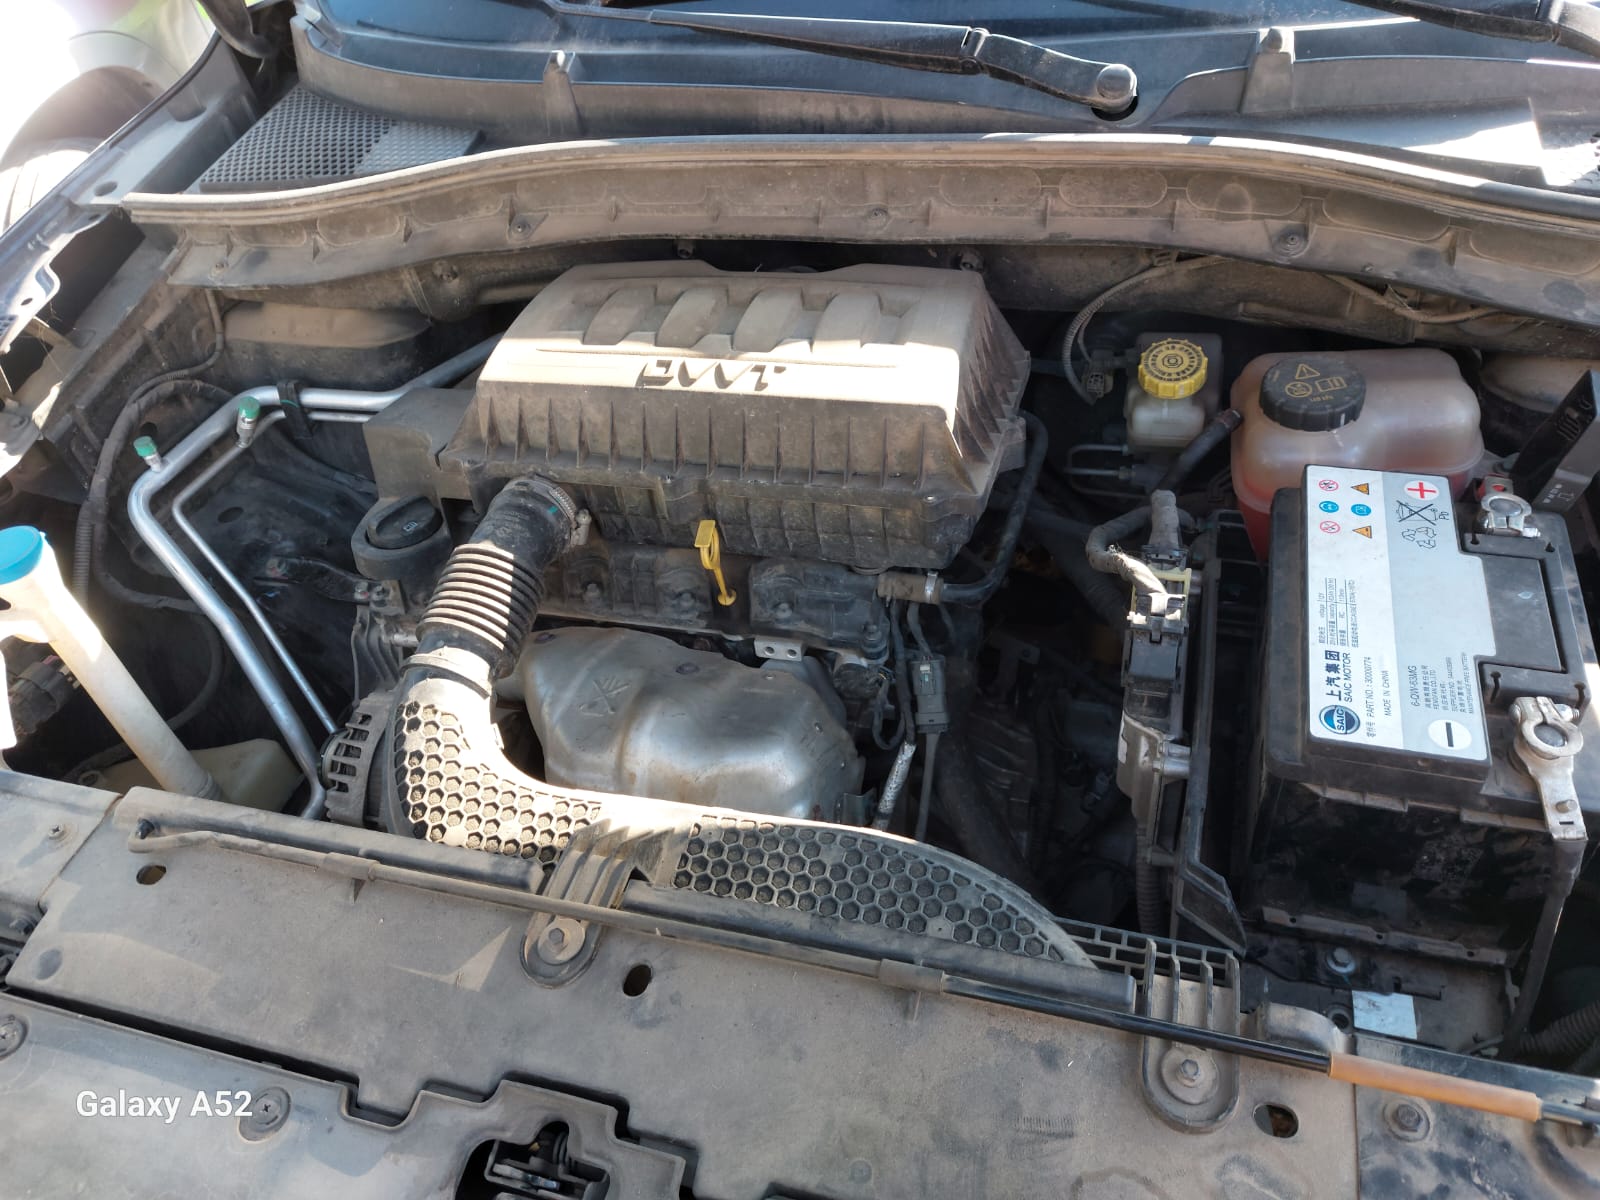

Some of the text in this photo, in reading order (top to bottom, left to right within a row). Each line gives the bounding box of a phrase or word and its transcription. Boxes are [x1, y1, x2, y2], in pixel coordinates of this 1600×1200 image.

[1324, 650, 1342, 701] 上汽集团
[1342, 652, 1352, 681] MOTOR
[1381, 670, 1390, 689] CHINA
[1343, 683, 1352, 703] SAIC
[1365, 700, 1375, 718] PART
[1382, 699, 1392, 717] MADE
[1336, 708, 1345, 731] SAIC
